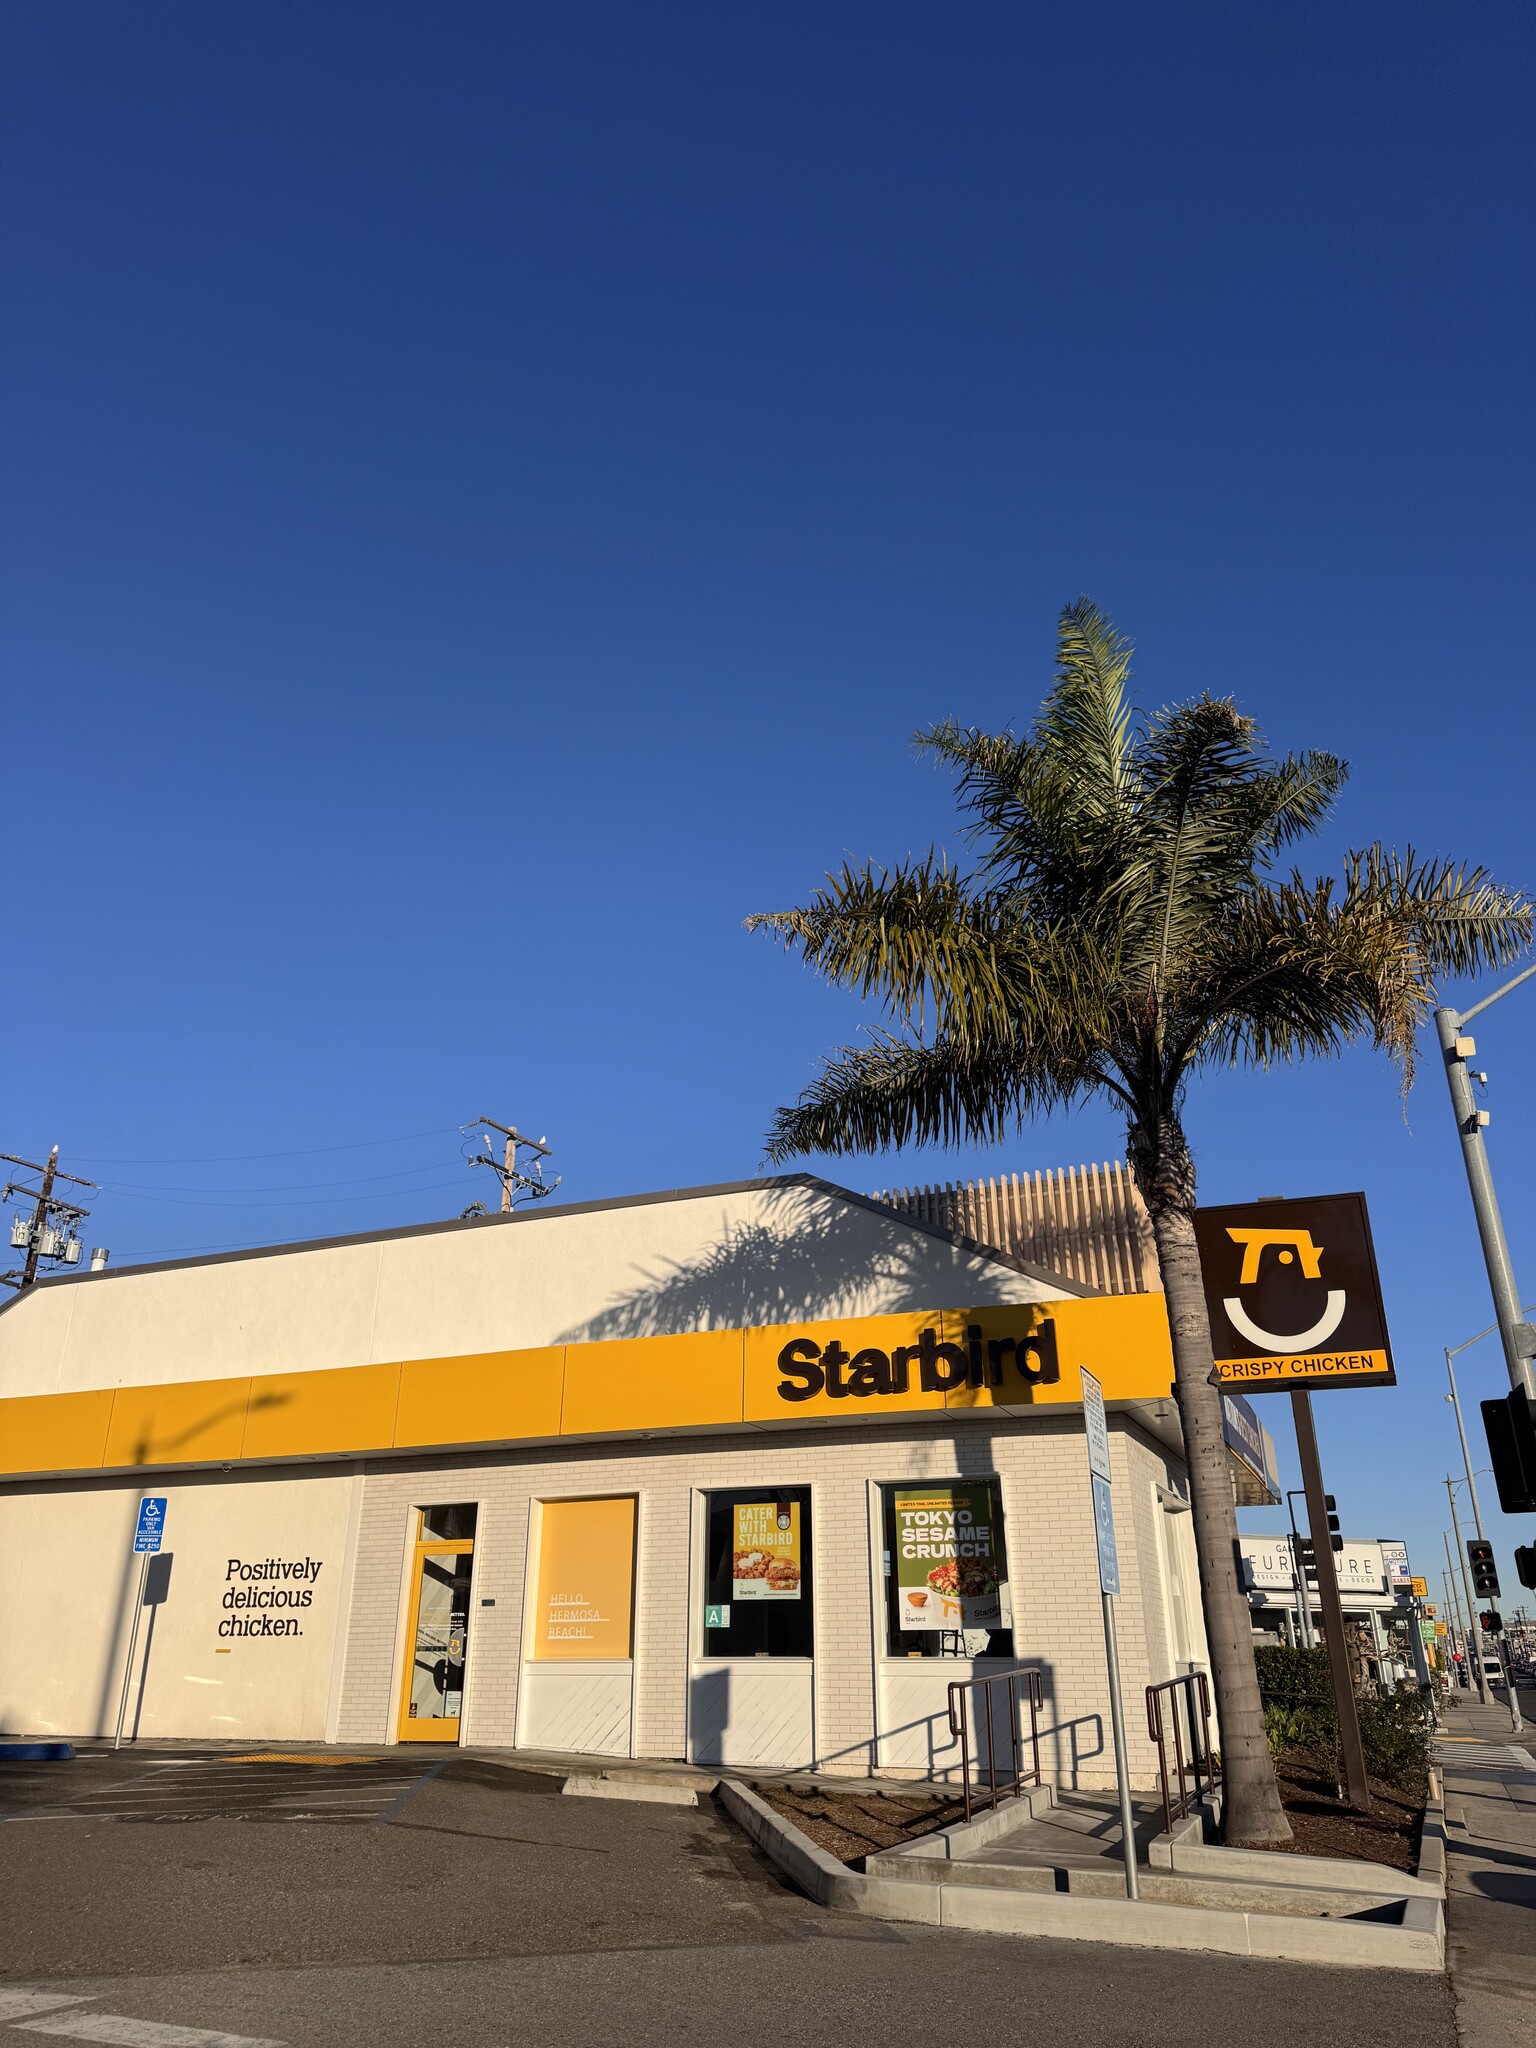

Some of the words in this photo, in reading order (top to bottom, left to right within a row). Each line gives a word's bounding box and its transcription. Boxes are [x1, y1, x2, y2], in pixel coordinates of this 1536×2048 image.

[777, 1318, 1060, 1402] Starbird
[1219, 1361, 1284, 1377] CRISPY
[1291, 1355, 1374, 1373] CHICKEN
[739, 1507, 773, 1520] CATER
[901, 1510, 973, 1526] TOKYO
[739, 1520, 767, 1533] WITH
[901, 1526, 990, 1542] SESAME
[739, 1532, 793, 1546] STARBIRD
[902, 1542, 990, 1559] CRUNCH
[225, 1556, 323, 1583] Positively
[1249, 1555, 1373, 1574] FURURE
[222, 1586, 313, 1609] delicious
[551, 1594, 583, 1603] HELLO
[550, 1610, 600, 1620] HERMOSA
[709, 1610, 719, 1623] A
[218, 1614, 303, 1637] chicken.
[549, 1627, 586, 1637] BEACH!
